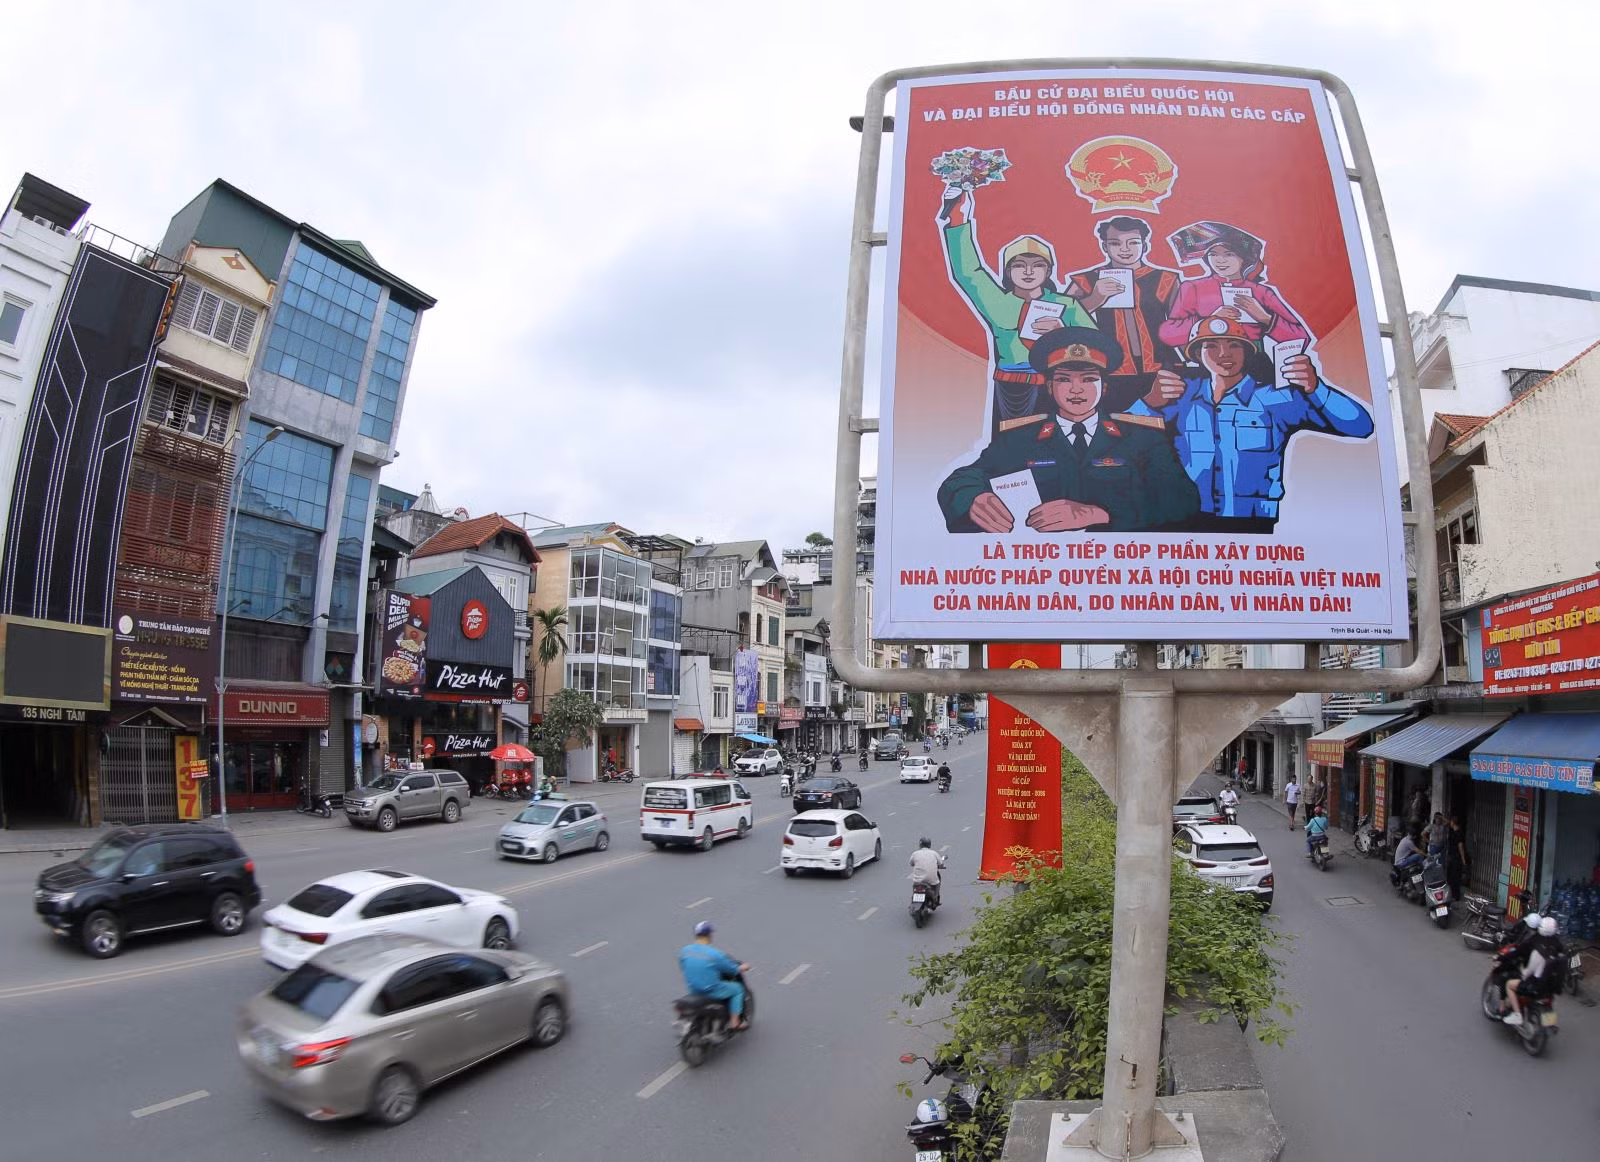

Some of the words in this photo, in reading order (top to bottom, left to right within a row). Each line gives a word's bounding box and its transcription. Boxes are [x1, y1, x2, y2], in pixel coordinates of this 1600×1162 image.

[995, 86, 1030, 100] BẦU
[1038, 84, 1063, 99] CỬ
[1068, 88, 1097, 100] ĐẠI
[1104, 84, 1145, 98] BIỂU
[1152, 86, 1199, 100] QUỐC
[1205, 89, 1234, 104] HỘI
[924, 108, 946, 122] VÀ
[952, 108, 982, 121] ĐẠI
[988, 100, 1030, 117] BIỂU
[1037, 102, 1067, 117] HỘI
[1073, 100, 1124, 115] ĐỒNG
[1130, 102, 1182, 116] NHÂN
[1188, 104, 1225, 118] DÂN
[1231, 104, 1266, 120] CÁC
[1271, 108, 1306, 123] CẤP
[983, 542, 1006, 560] LÀ
[1012, 542, 1060, 562] TRỰC
[1066, 538, 1106, 560] TIẾP
[1114, 540, 1151, 560] GÓP
[1158, 539, 1208, 560] PHẦN
[1215, 542, 1249, 560] XÂY
[1256, 544, 1304, 564] DỰNG
[900, 566, 938, 585] NHÀ
[945, 565, 996, 585] NƯỚC
[1001, 566, 1052, 585] PHÁP
[1058, 564, 1121, 586] QUYỀN
[1128, 566, 1153, 585] XÃ
[1159, 566, 1190, 588] HỘI
[1197, 563, 1233, 585] CHỦ
[1240, 568, 1295, 586] NGHĨA
[1301, 568, 1336, 589] VIỆT
[1342, 572, 1381, 588] NAM
[389, 606, 407, 616] DEAL
[934, 589, 971, 610] CỦA
[978, 592, 1030, 610] NHÂN
[1037, 592, 1083, 612] DÂN,
[1090, 595, 1114, 610] DO
[1121, 592, 1174, 611] NHÂN
[1180, 592, 1225, 613] DÂN,
[1230, 592, 1247, 611] VÌ
[1254, 593, 1304, 612] NHÂN
[1310, 593, 1352, 612] DÂN!
[467, 616, 482, 626] Pizza
[1536, 618, 1554, 635] GAS
[1555, 616, 1563, 631] &
[1564, 605, 1585, 629] BẾP
[1585, 656, 1600, 669] 427
[437, 665, 476, 688] Pizza
[479, 668, 506, 689] Hut
[22, 707, 37, 718] 135
[239, 700, 297, 714] DUNNIO
[445, 735, 471, 751] Pizza
[472, 736, 491, 749] Hut
[1020, 728, 1034, 737] QUỐC
[180, 740, 197, 817] 137
[1496, 757, 1513, 774] BẾP
[1514, 762, 1533, 777] GAS
[1535, 761, 1555, 779] HỮU
[1557, 763, 1576, 782] TÍN
[1512, 835, 1527, 859] GAS
[1510, 864, 1525, 889] HỮU
[1508, 895, 1520, 919] TÍN
